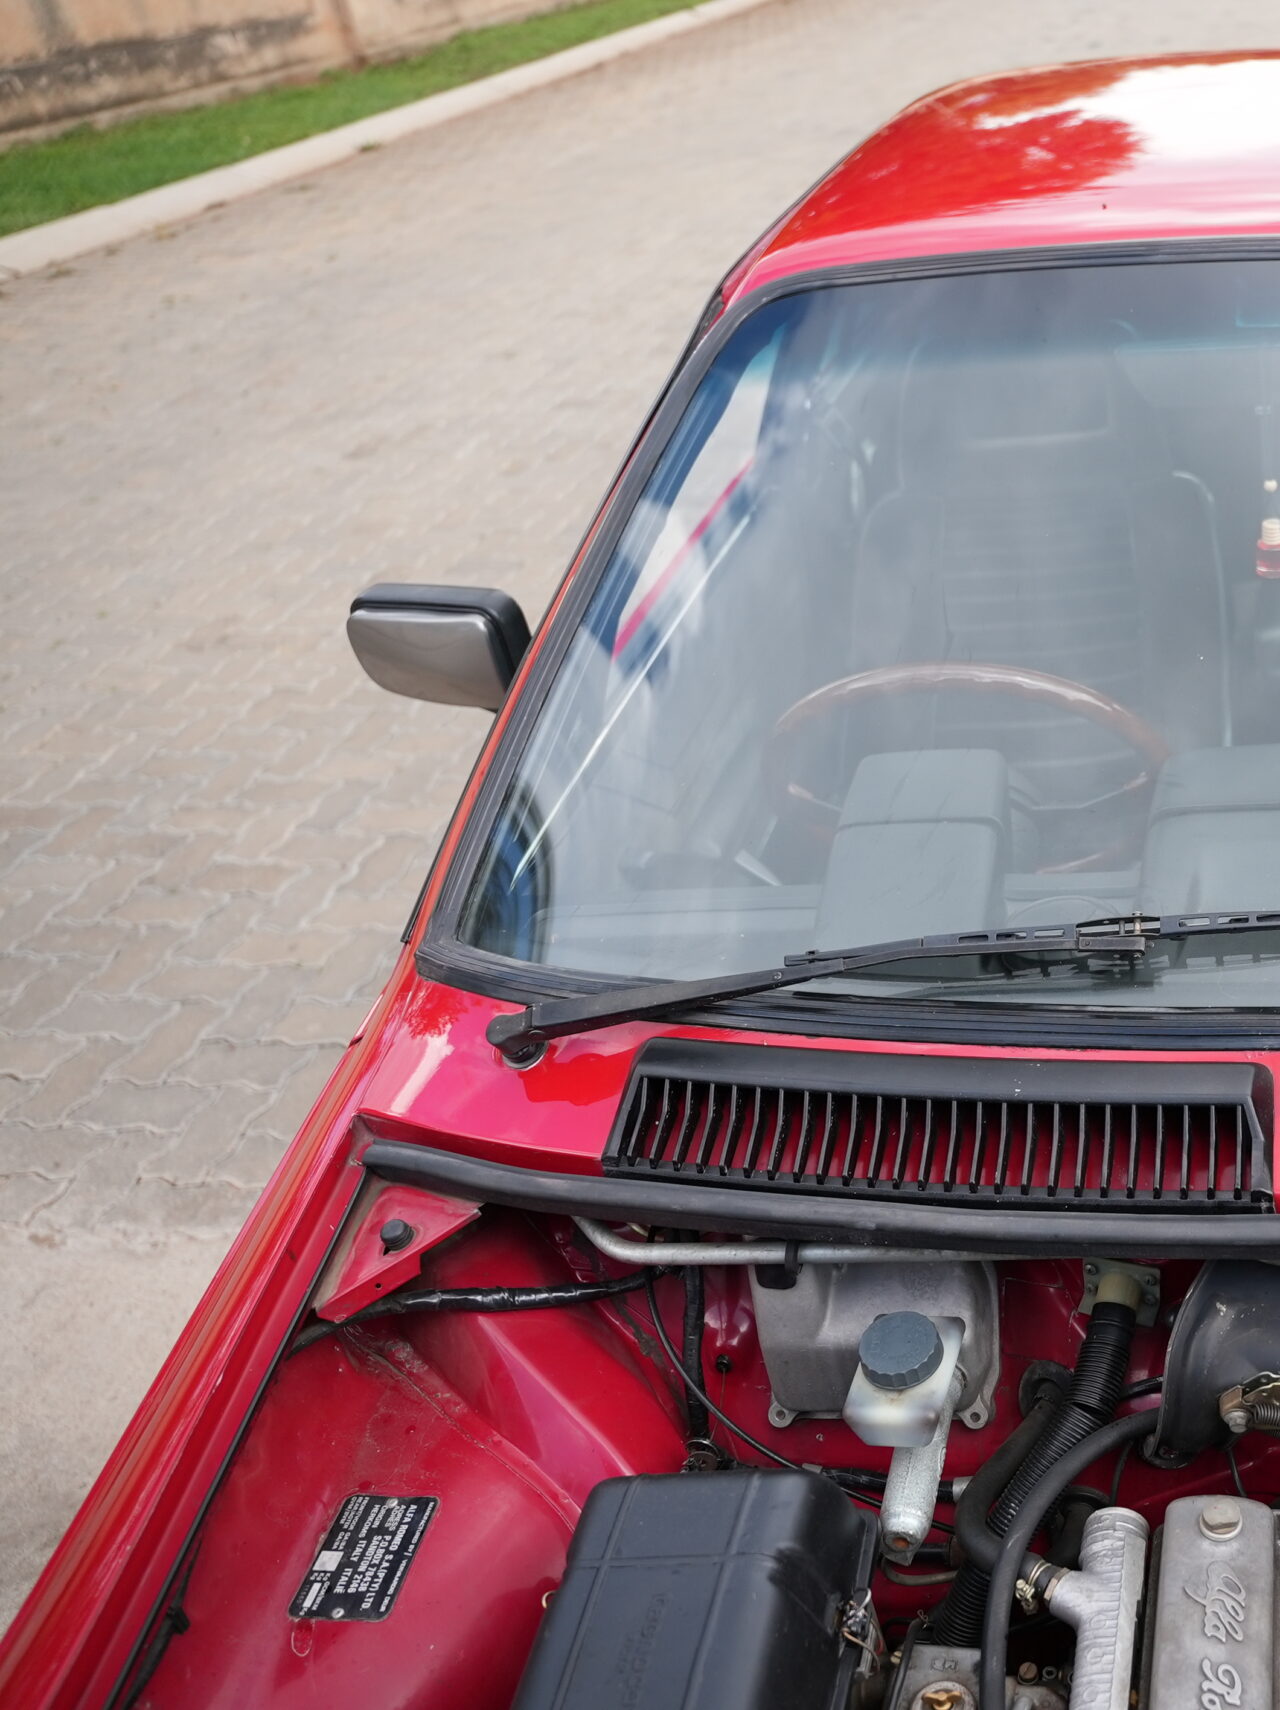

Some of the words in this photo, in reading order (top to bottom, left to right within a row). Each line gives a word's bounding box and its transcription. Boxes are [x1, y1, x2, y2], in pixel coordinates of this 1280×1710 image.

[358, 1504, 380, 1538] HERKOMS
[371, 1504, 389, 1528] ORIGIN
[402, 1504, 417, 1523] ALFA
[388, 1524, 408, 1551] ROMEO
[349, 1540, 367, 1562] ITALY
[357, 1535, 382, 1572] SANDTON
[347, 1574, 363, 1594] 2146
[359, 1592, 375, 1611] LTD.
[1182, 1560, 1247, 1643] Alfa
